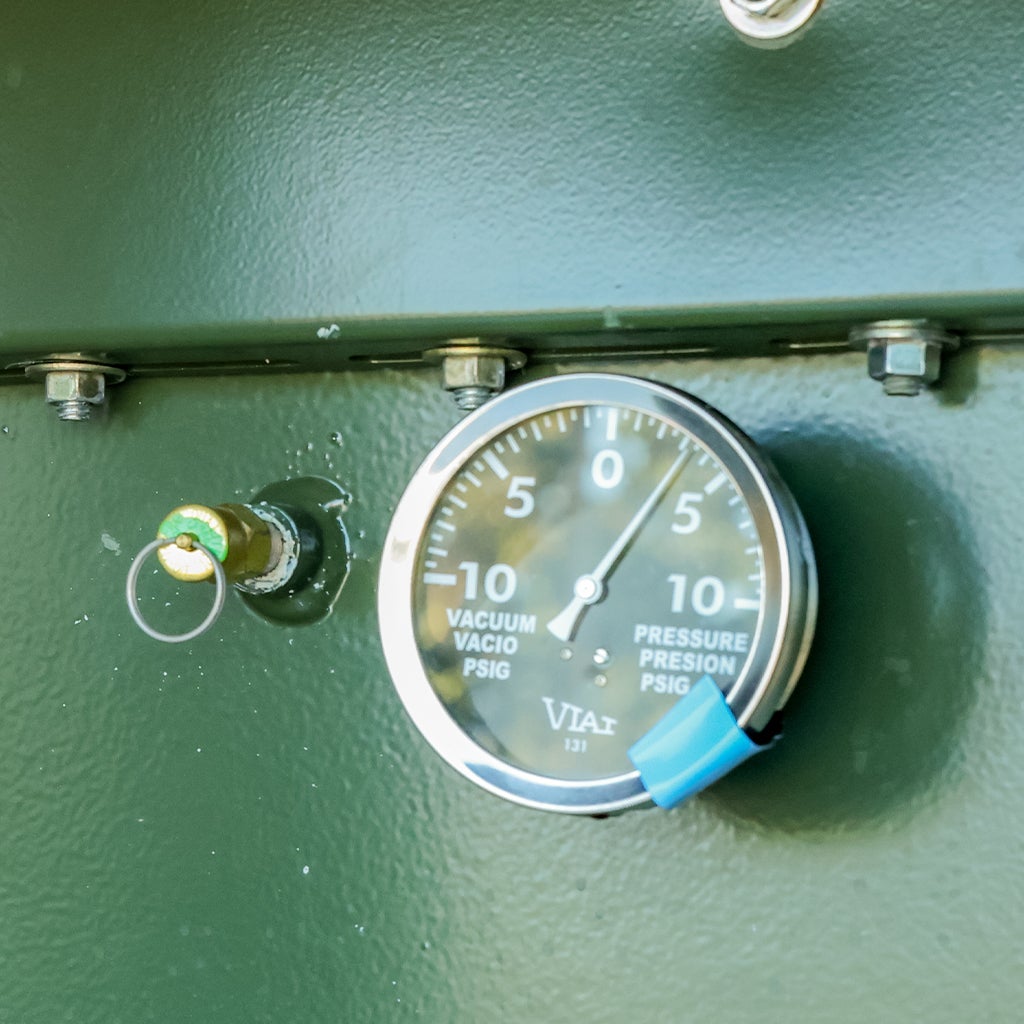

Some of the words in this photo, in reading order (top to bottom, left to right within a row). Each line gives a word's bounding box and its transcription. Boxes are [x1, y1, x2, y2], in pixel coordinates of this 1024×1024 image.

[592, 449, 624, 488] 0
[504, 477, 535, 518] 5
[671, 492, 702, 534] 5
[458, 562, 517, 603] 10
[667, 574, 725, 616] 10
[446, 608, 536, 633] VACUUM
[453, 631, 518, 655] VACIO
[634, 624, 749, 653] PRESSURE
[463, 657, 510, 680] PSIG
[639, 648, 736, 676] PRESION
[640, 672, 692, 696] PSIG
[564, 738, 587, 753] 131
